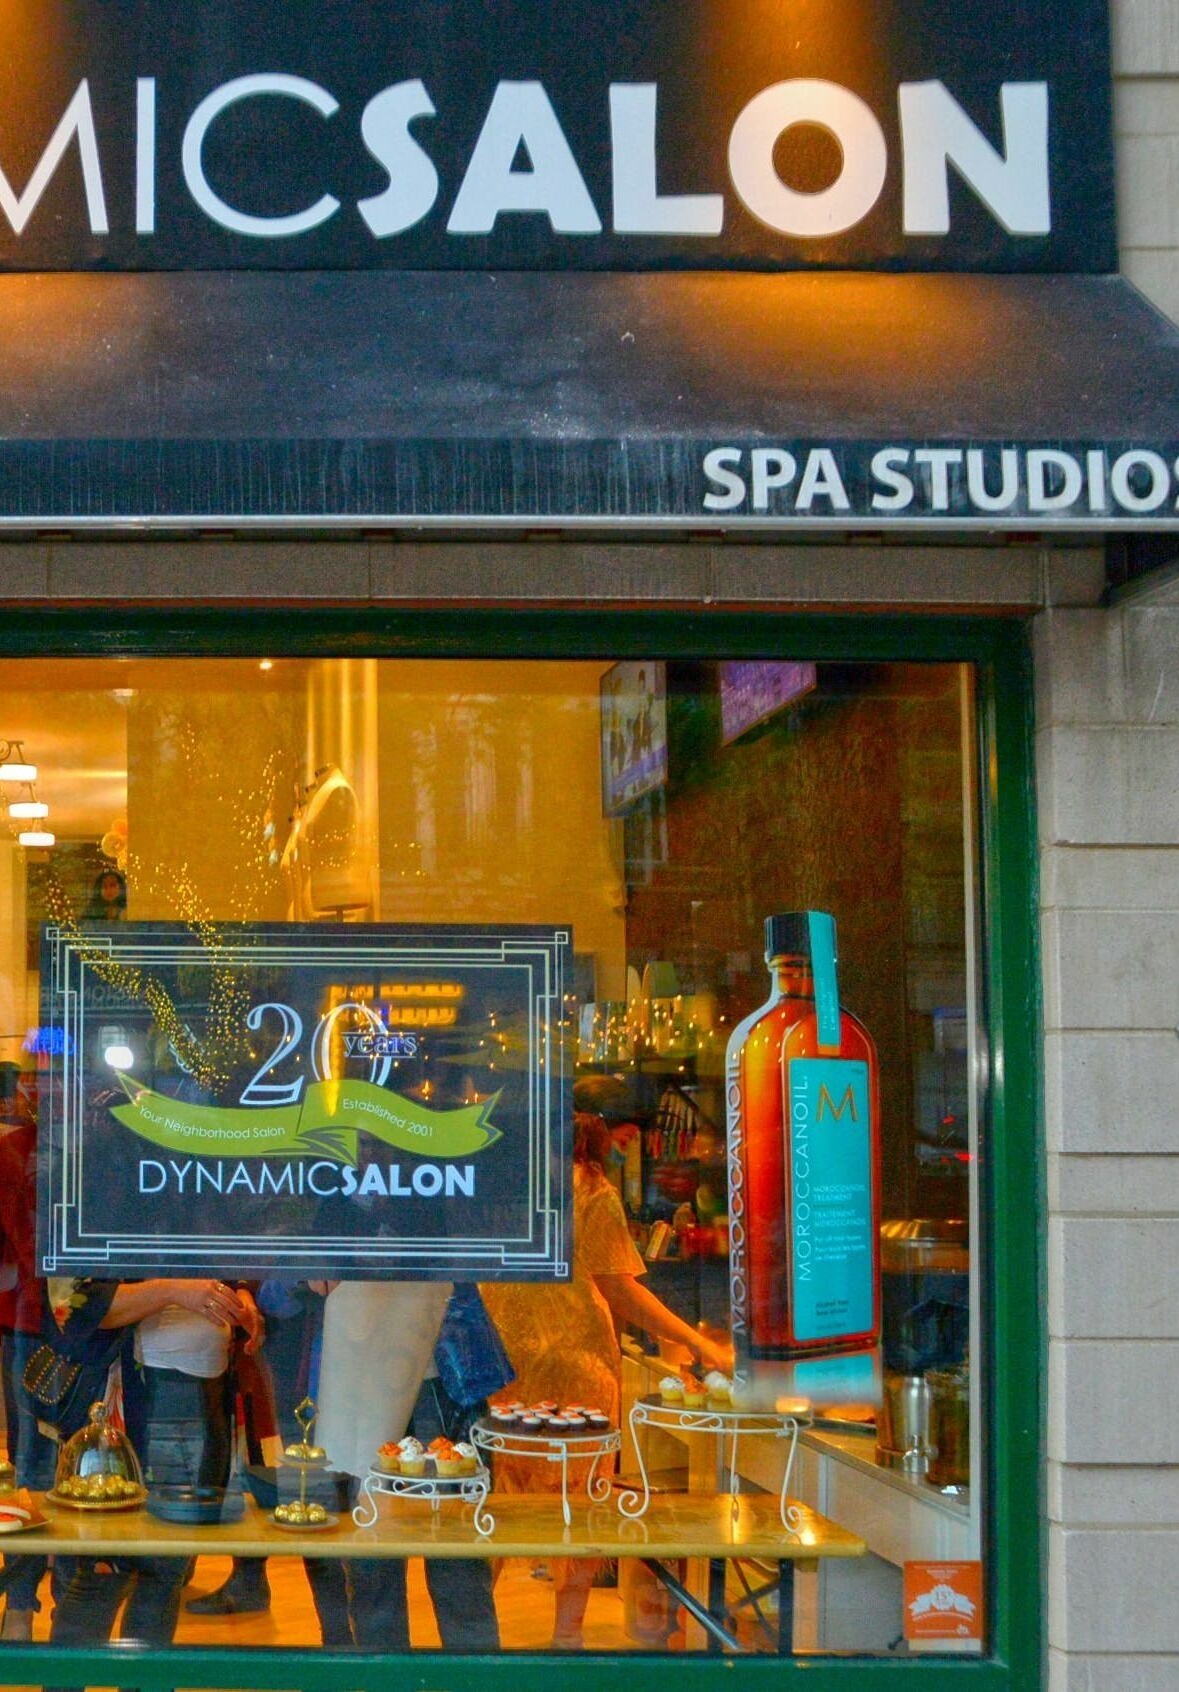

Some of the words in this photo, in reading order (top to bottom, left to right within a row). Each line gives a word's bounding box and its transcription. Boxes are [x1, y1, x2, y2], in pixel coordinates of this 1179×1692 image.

[702, 447, 850, 510] SPA
[870, 447, 1179, 512] STUDIO
[239, 1002, 392, 1104] 20
[343, 1035, 418, 1057] years
[139, 1105, 164, 1124] Your
[164, 1118, 250, 1139] Neighborhood
[253, 1126, 285, 1138] Salon
[342, 1098, 407, 1128] Established
[407, 1122, 433, 1137] 2001
[815, 1083, 858, 1122] M
